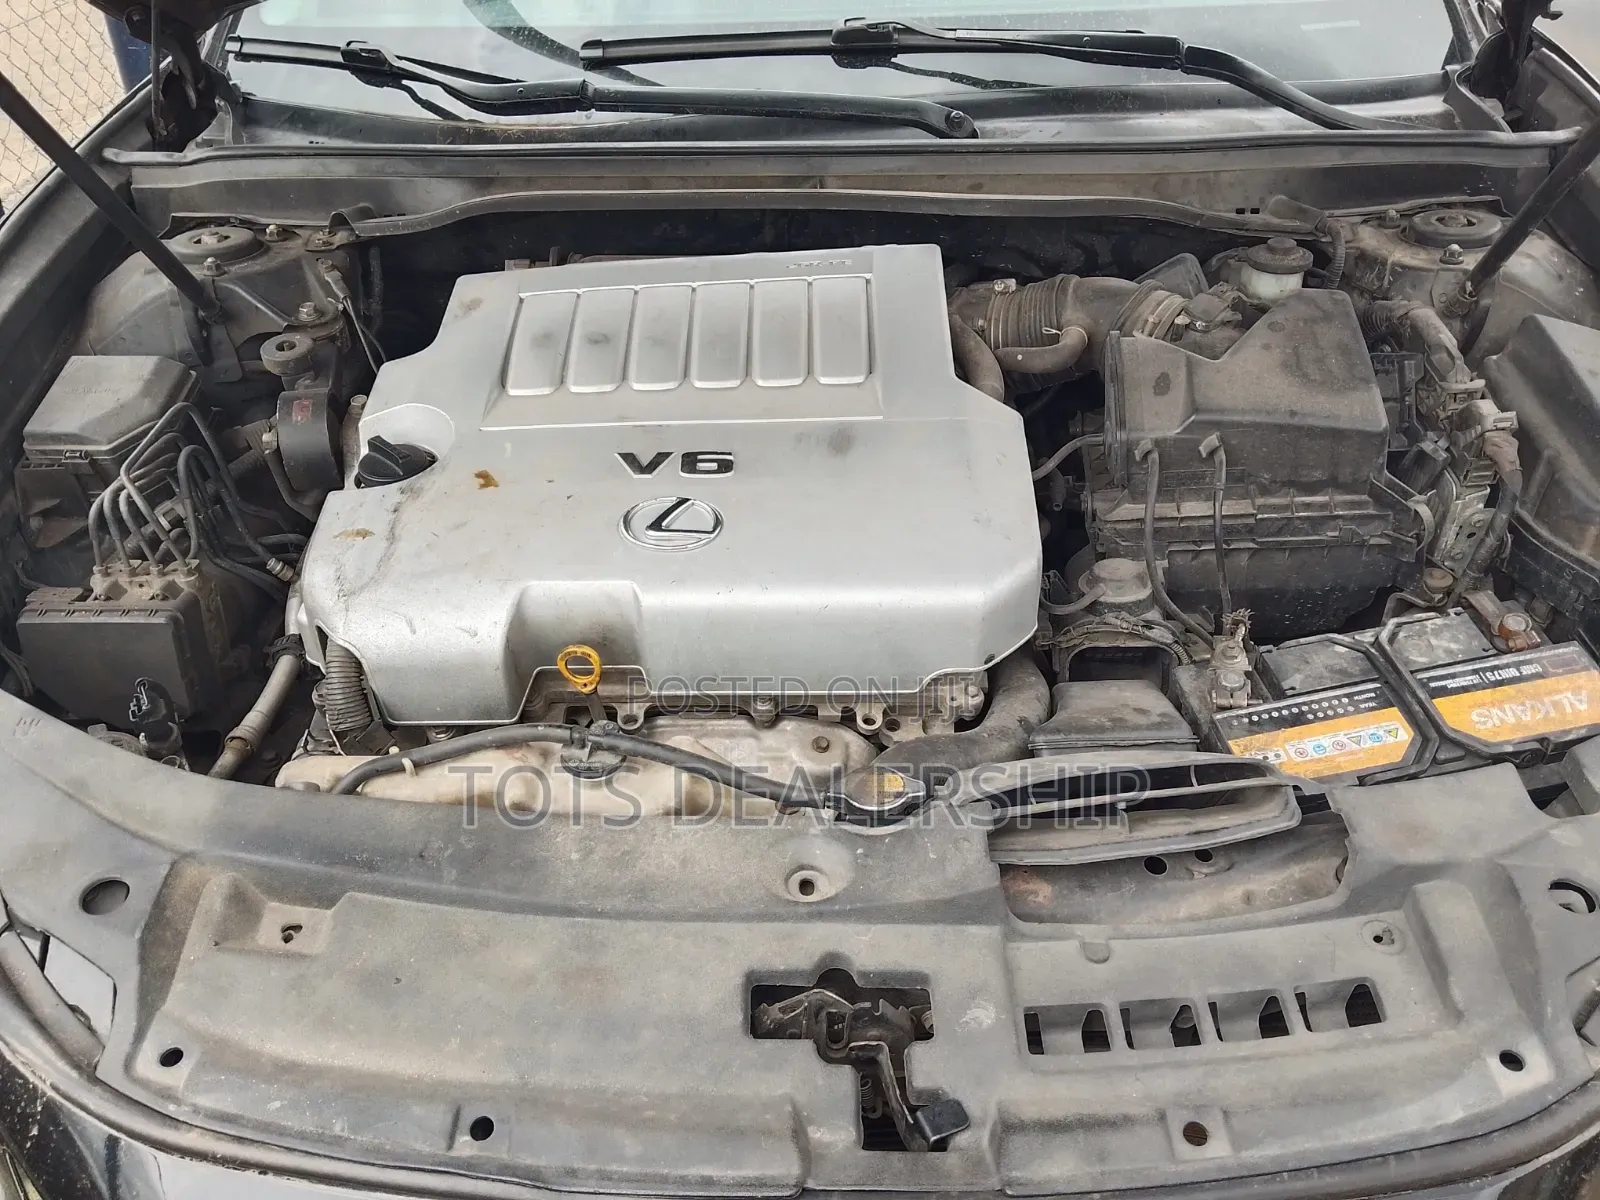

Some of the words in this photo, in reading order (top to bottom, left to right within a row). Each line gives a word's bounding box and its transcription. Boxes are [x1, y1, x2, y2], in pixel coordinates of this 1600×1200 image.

[614, 451, 734, 478] V6
[1353, 692, 1376, 701] MONTH
[1471, 690, 1588, 730] ALKANS
